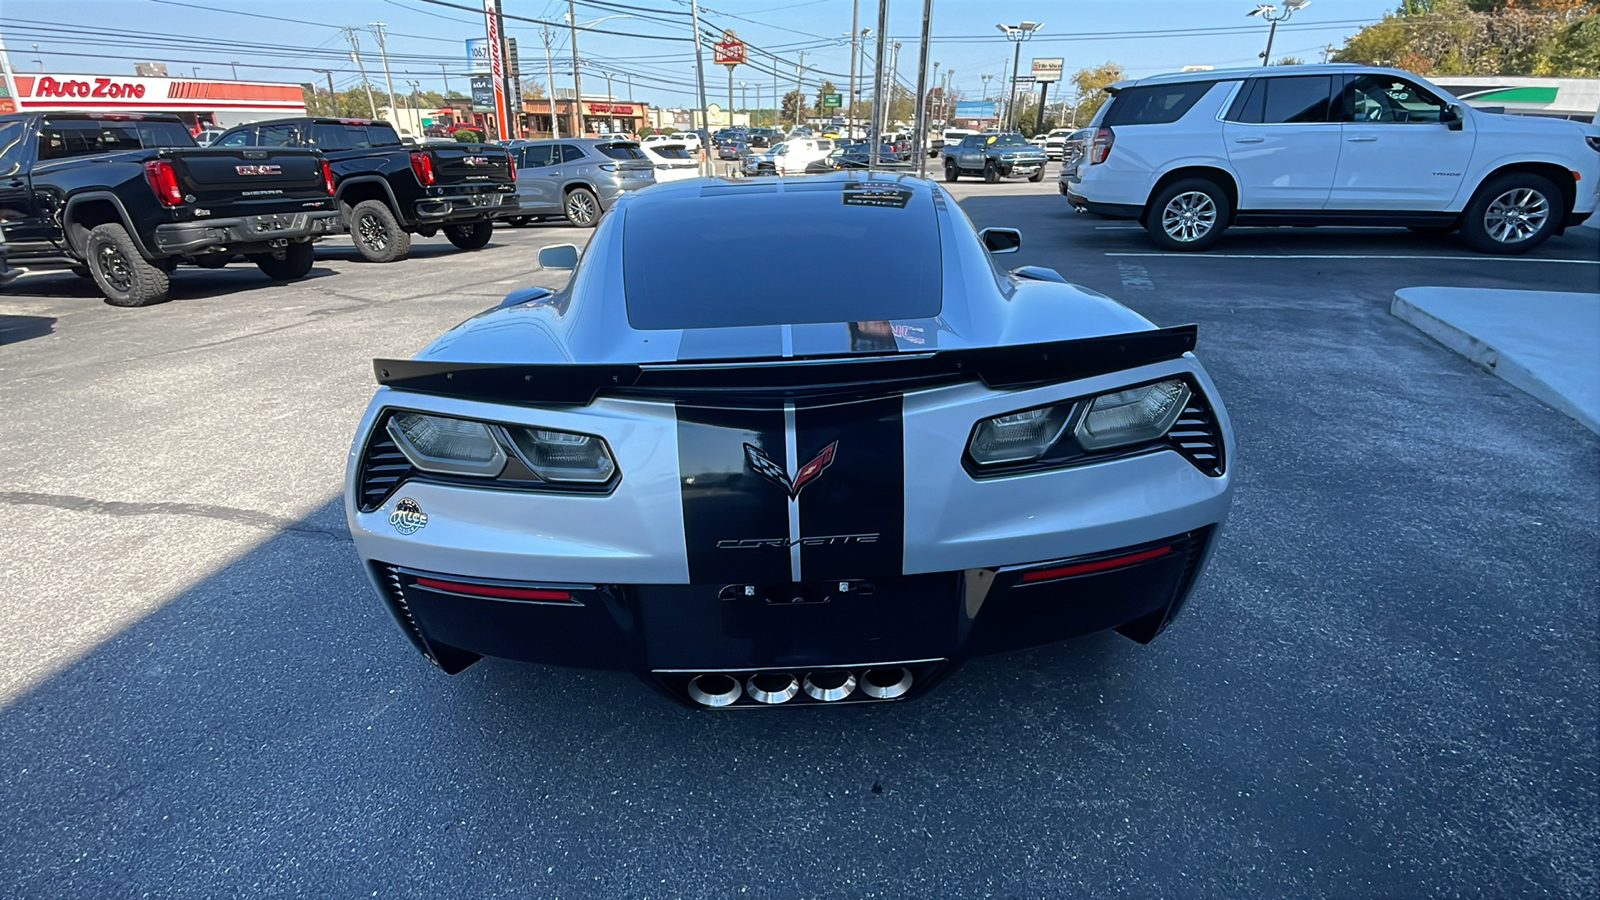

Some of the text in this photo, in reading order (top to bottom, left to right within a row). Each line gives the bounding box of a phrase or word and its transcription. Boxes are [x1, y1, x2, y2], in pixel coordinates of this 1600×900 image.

[487, 6, 501, 76] AutoZone
[36, 76, 145, 99] AutoZone
[236, 165, 281, 175] GMC
[716, 533, 880, 548] CORVETTE
